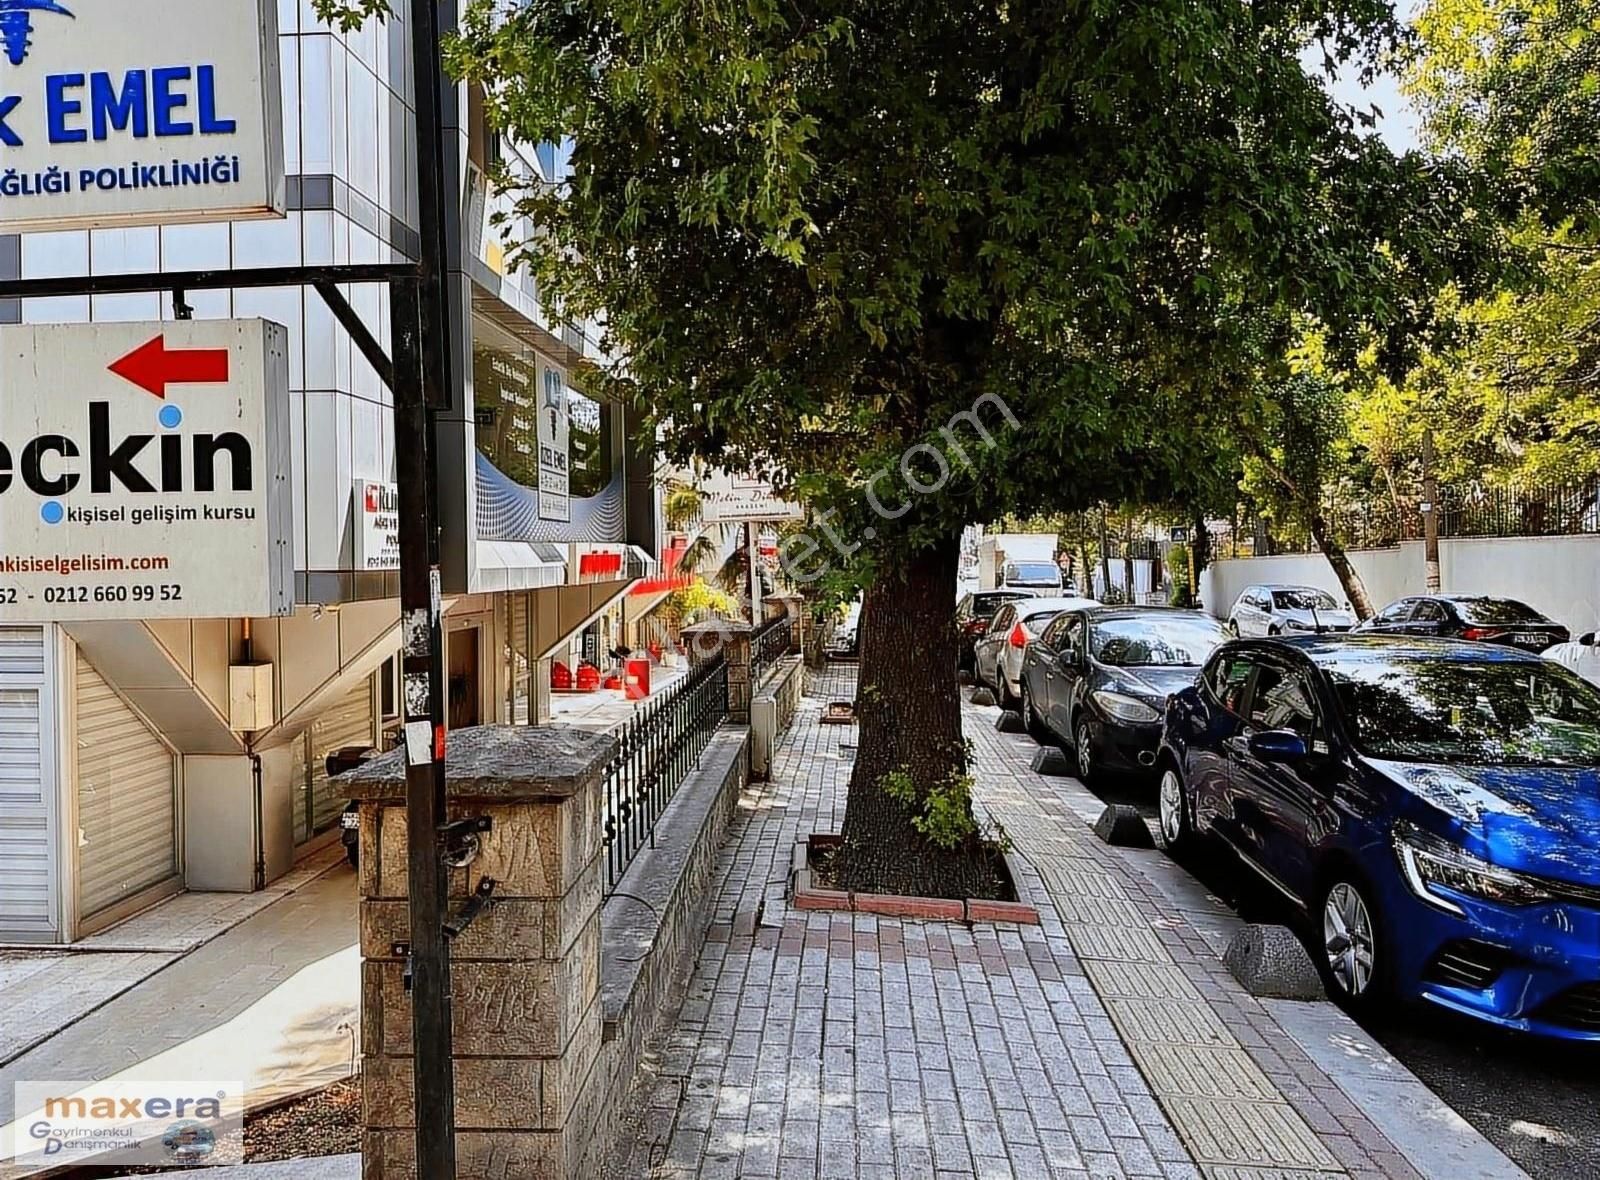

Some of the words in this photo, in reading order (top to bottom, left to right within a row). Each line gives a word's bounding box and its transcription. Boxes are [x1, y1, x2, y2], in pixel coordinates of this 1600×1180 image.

[45, 64, 237, 144] EMEL
[0, 165, 72, 197] ĞLIĞI
[79, 155, 240, 192] POLİKLİNİĞİ
[67, 506, 125, 525] kişisel
[131, 505, 197, 524] gelişim
[203, 504, 256, 520] kursu
[44, 586, 88, 603] 0212
[94, 585, 127, 602] 660
[132, 585, 155, 601] 99
[160, 584, 182, 601] 52
